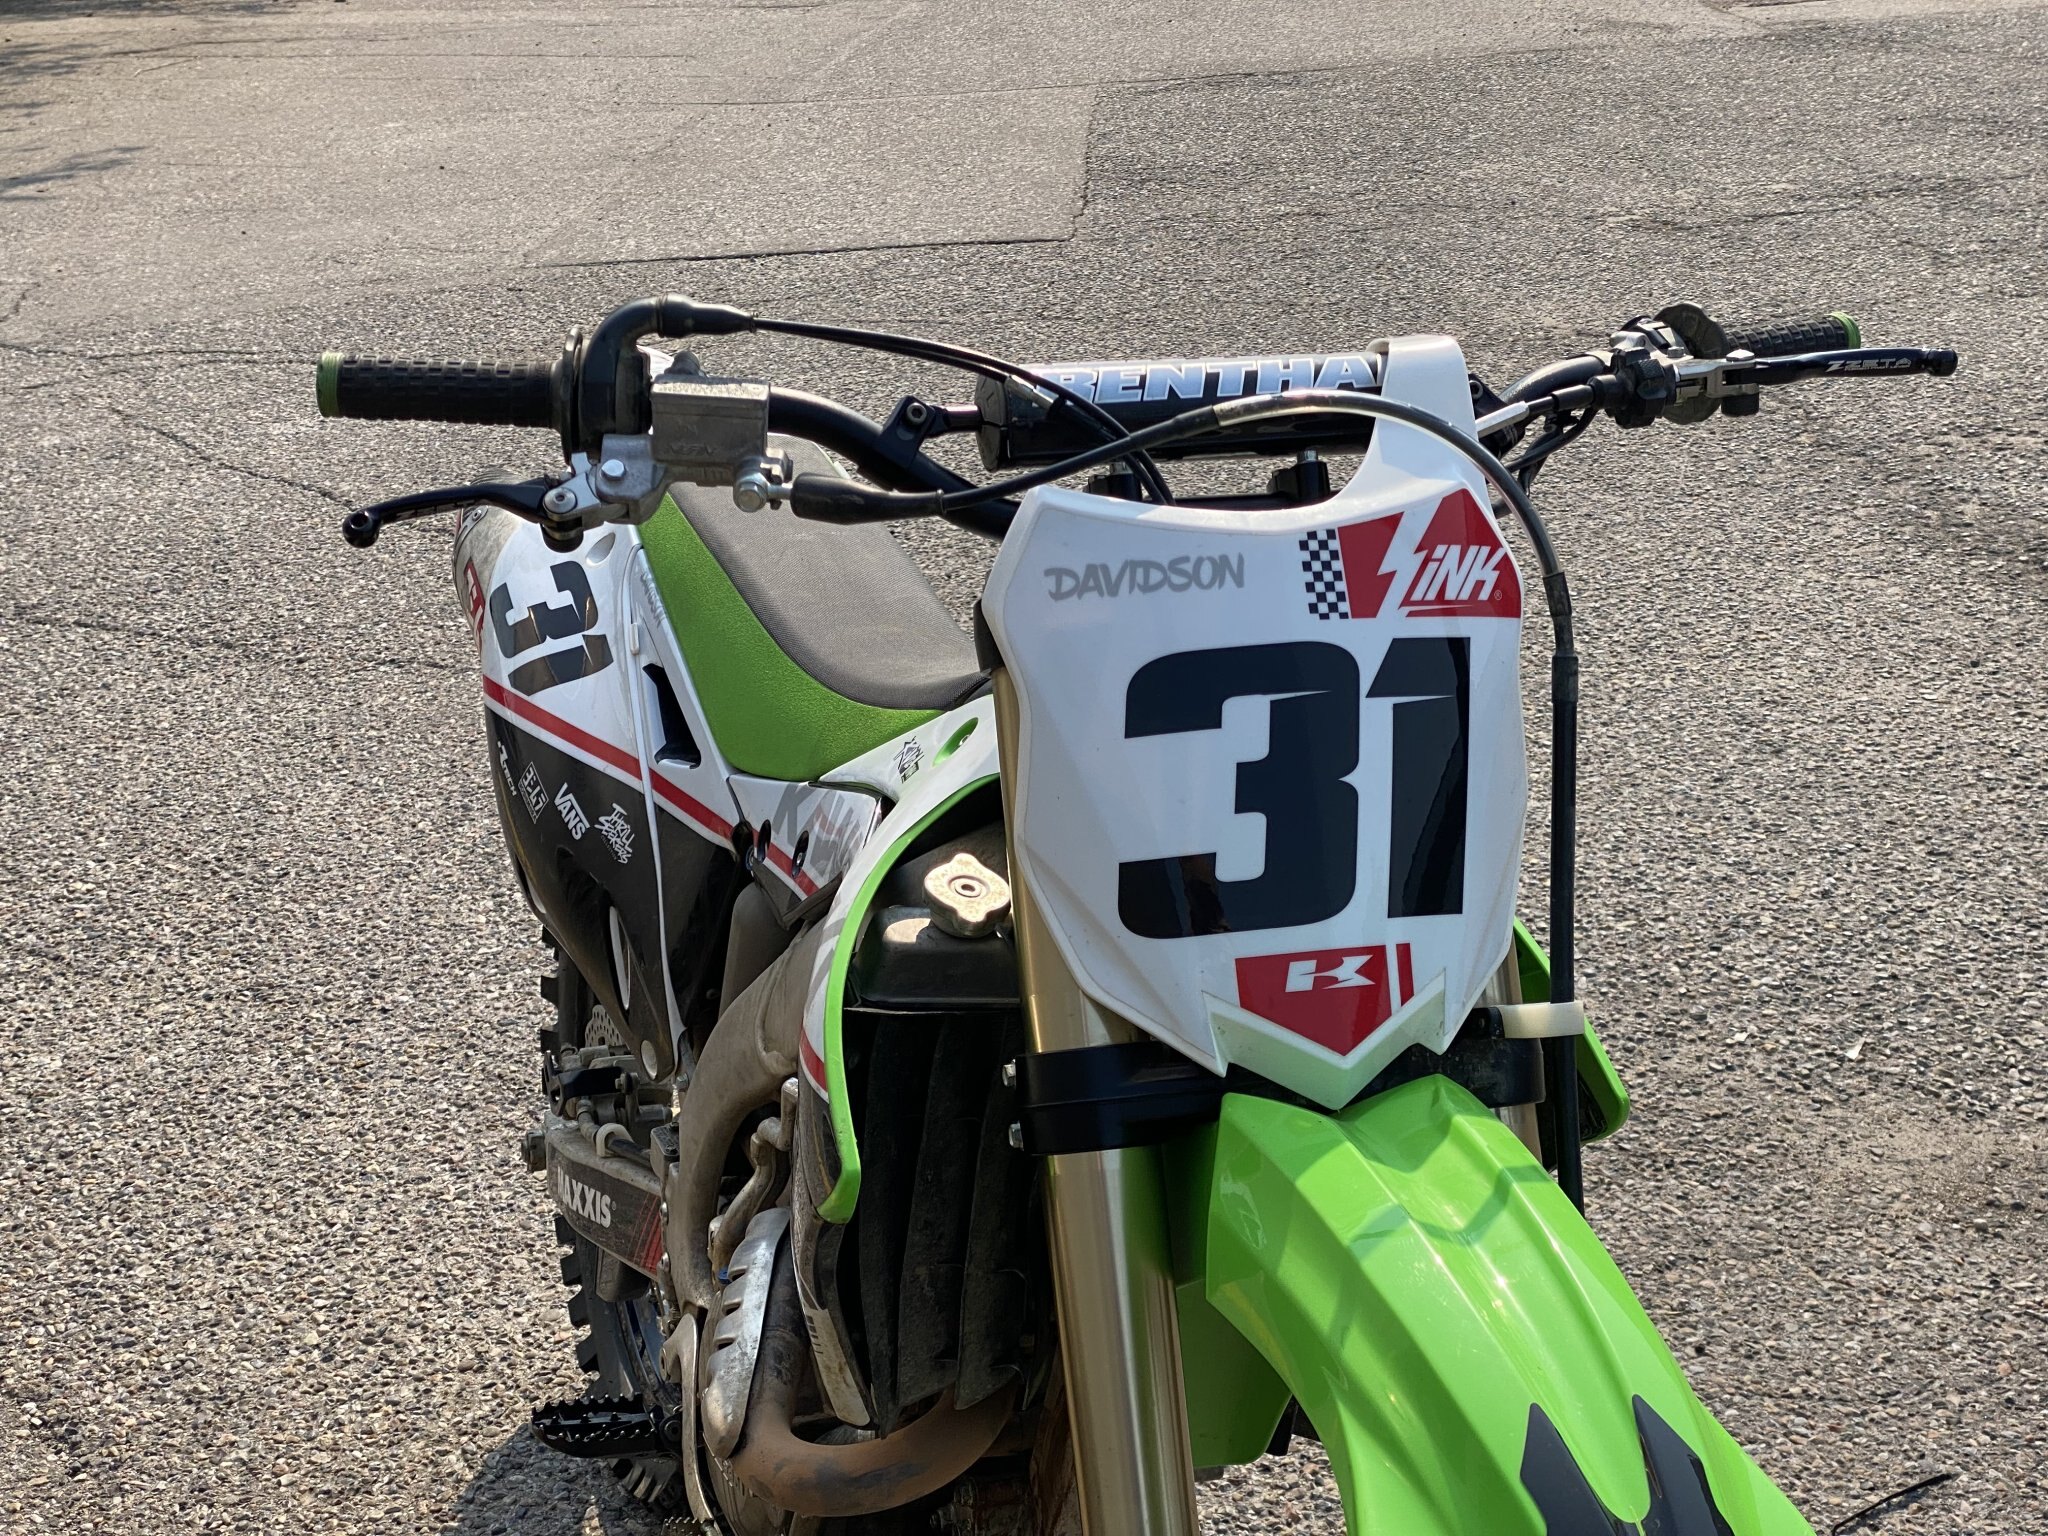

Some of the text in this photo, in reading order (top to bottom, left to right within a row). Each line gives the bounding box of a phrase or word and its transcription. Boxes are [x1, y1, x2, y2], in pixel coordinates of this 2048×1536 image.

[1044, 552, 1245, 602] DAVIDSON
[489, 560, 614, 697] 31
[554, 782, 590, 841] VANS
[1117, 636, 1471, 940] 31
[557, 1165, 612, 1229] MAXXIS
